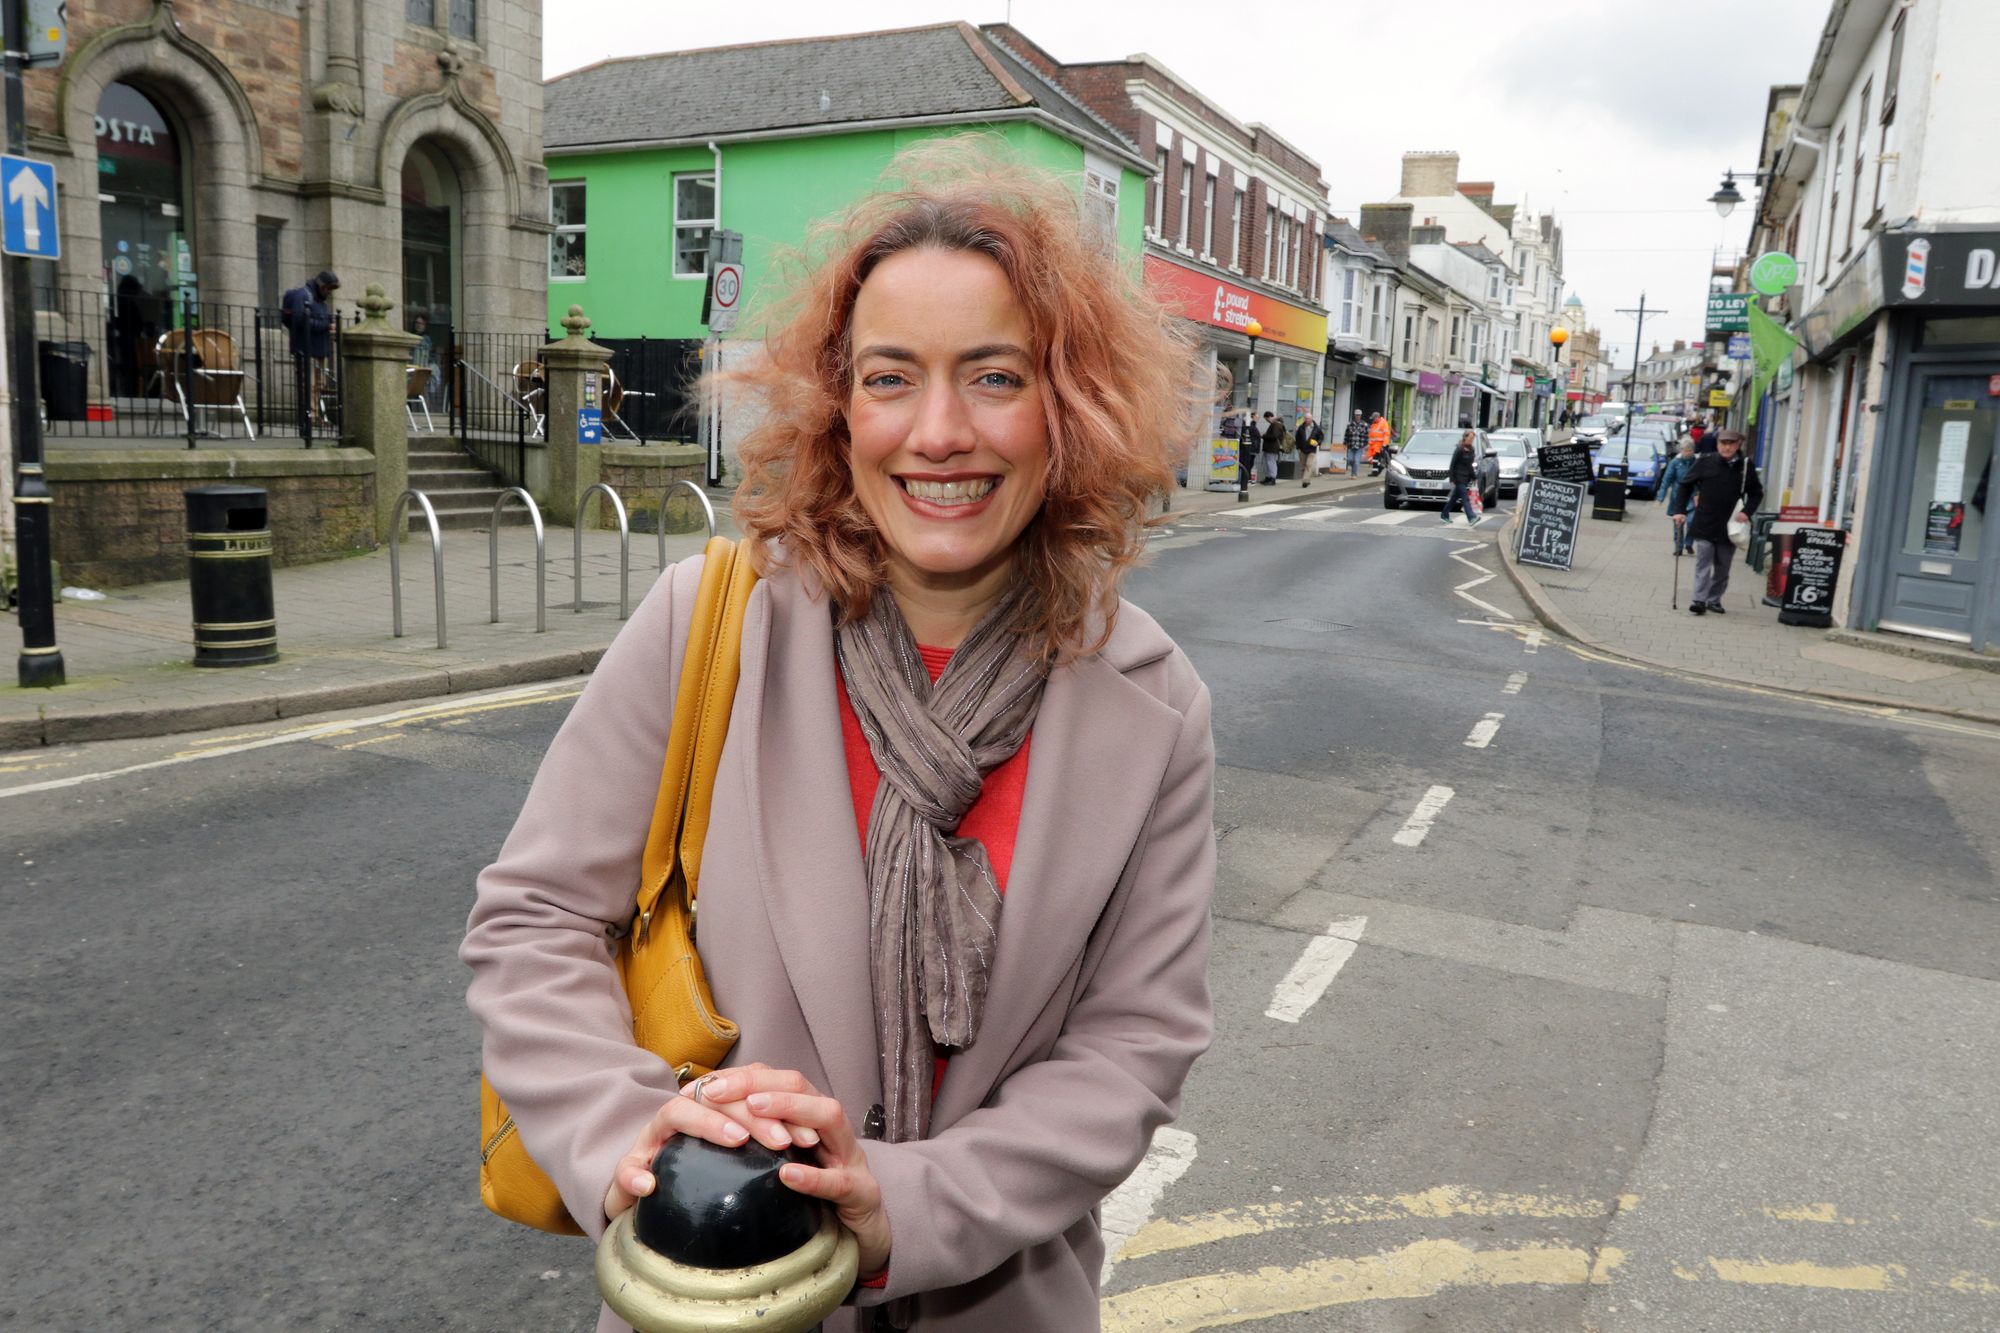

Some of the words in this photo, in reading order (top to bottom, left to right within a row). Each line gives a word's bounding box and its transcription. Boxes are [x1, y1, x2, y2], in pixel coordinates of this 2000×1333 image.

[95, 115, 155, 146] OSTA
[719, 279, 736, 296] 30
[1226, 292, 1249, 310] pound
[1709, 300, 1724, 309] TO
[1726, 299, 1746, 309] LET
[1546, 453, 1585, 462] CORNISH
[1541, 481, 1574, 494] WORLD
[1535, 489, 1577, 503] CHAMPION
[1533, 503, 1555, 514] STEAK
[1556, 508, 1576, 519] PASTY
